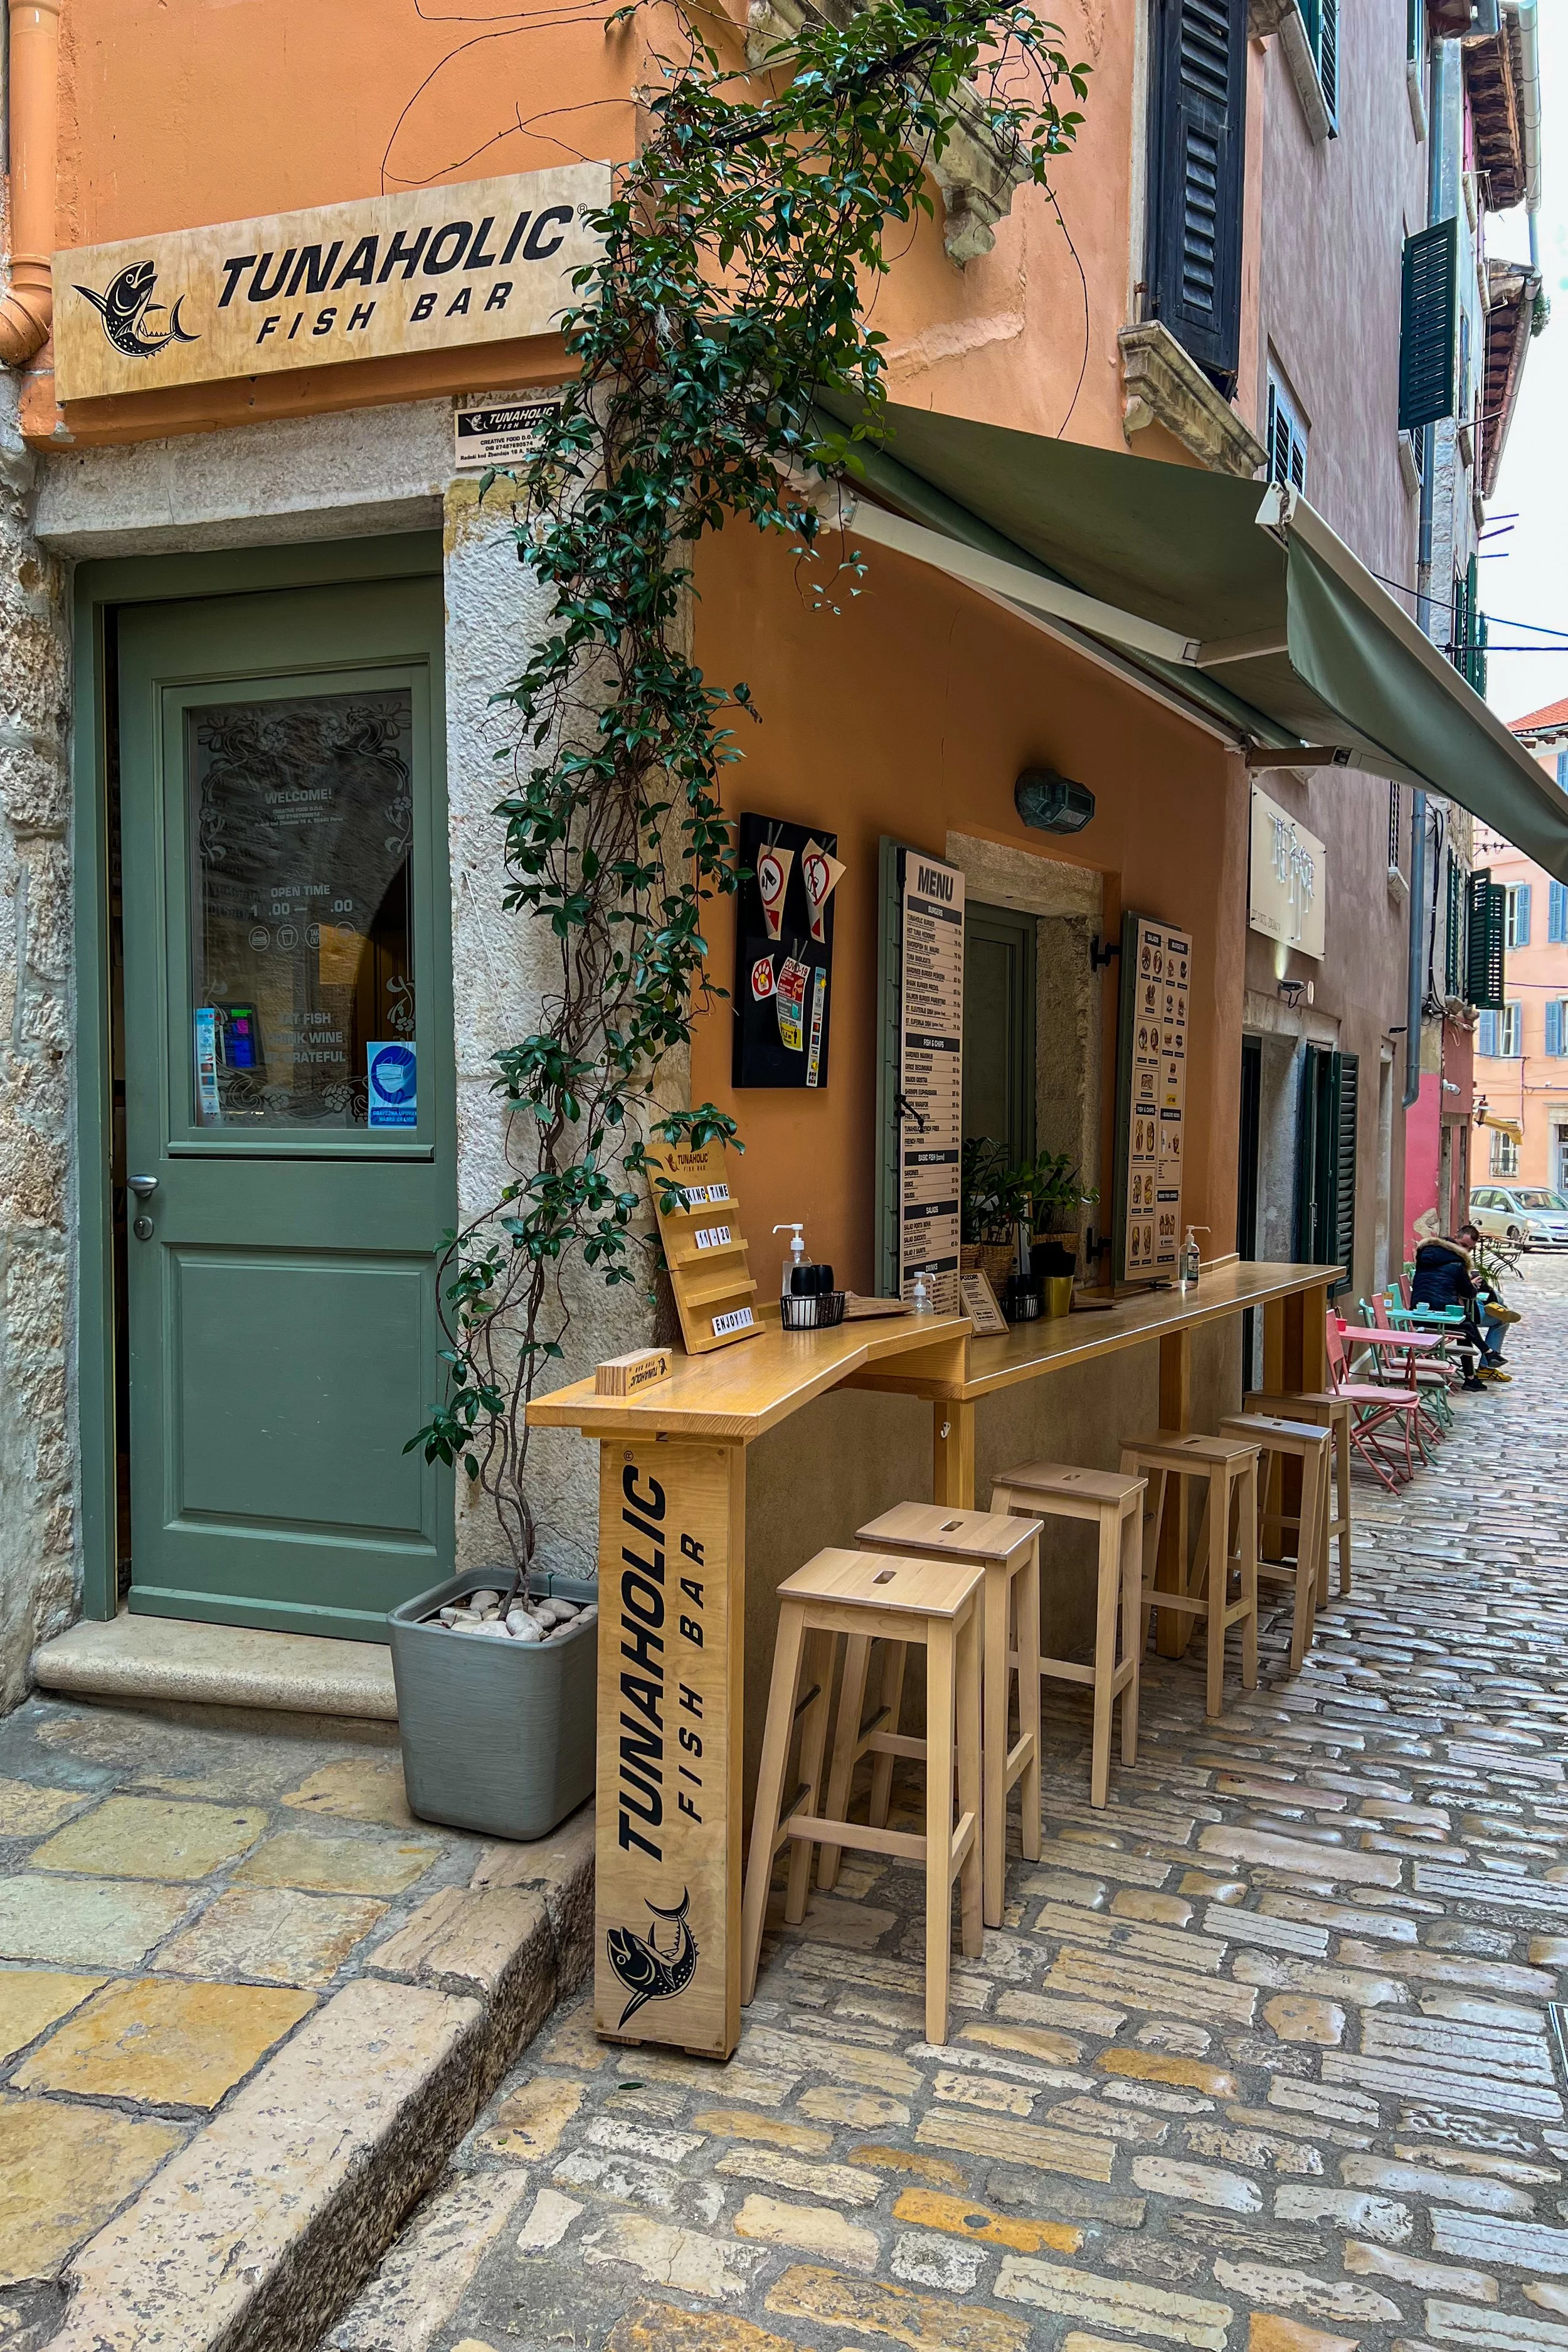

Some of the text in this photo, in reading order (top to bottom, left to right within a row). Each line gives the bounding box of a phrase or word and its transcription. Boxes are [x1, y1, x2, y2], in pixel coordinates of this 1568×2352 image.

[256, 280, 514, 344] FISH BAR
[489, 406, 554, 425] TUNAHOLIC
[497, 422, 519, 431] FISH
[265, 788, 332, 804] WELCOME!
[918, 865, 954, 902] MENU
[271, 886, 300, 898] OPEN
[305, 885, 331, 896] TIME
[928, 905, 943, 917] BURGERS
[1147, 933, 1159, 944] SALADS
[304, 1012, 331, 1024] FISH
[309, 1031, 343, 1044] WINE
[934, 1040, 945, 1048] CHIPS
[677, 1152, 708, 1166] TUNAHOLIC
[918, 1154, 928, 1162] BASIC
[710, 1185, 728, 1199] TIME
[926, 1205, 939, 1215] SALADS
[699, 1228, 729, 1245] 11 20
[679, 1531, 704, 1824] FISH BAR
